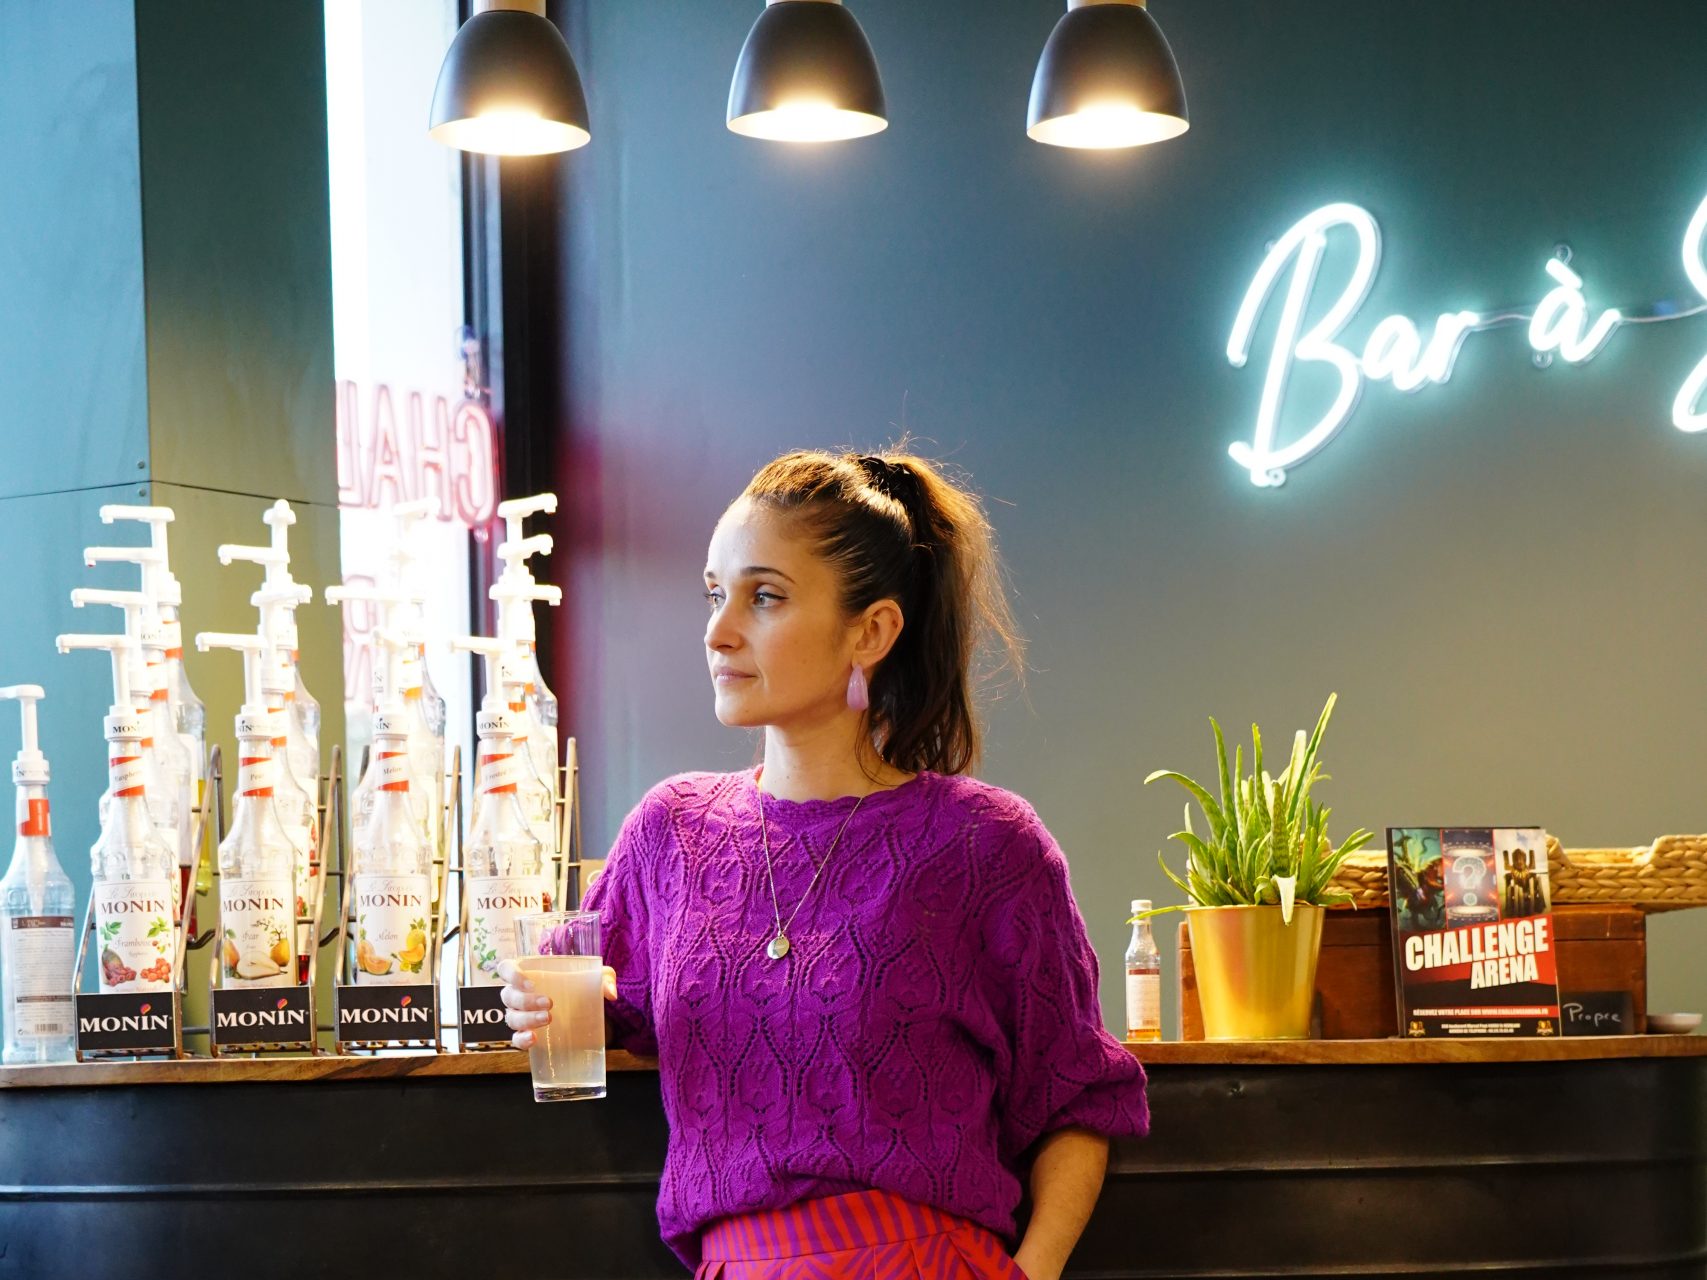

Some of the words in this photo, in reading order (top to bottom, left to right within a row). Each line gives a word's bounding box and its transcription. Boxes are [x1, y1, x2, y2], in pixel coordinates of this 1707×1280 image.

[1227, 203, 1481, 486] Bar
[1528, 258, 1622, 363] à
[101, 900, 165, 914] MONIN
[223, 898, 284, 913] MONIN
[360, 894, 422, 907] MONIN
[477, 896, 539, 910] MONIN
[1405, 918, 1549, 971] CHALLENGE
[1470, 954, 1539, 990] ARENA
[79, 1006, 168, 1033] MONIN
[217, 1002, 305, 1028] MONIN
[340, 999, 429, 1024] MONIN
[463, 1008, 504, 1025] MO
[1562, 1002, 1622, 1027] Propre
